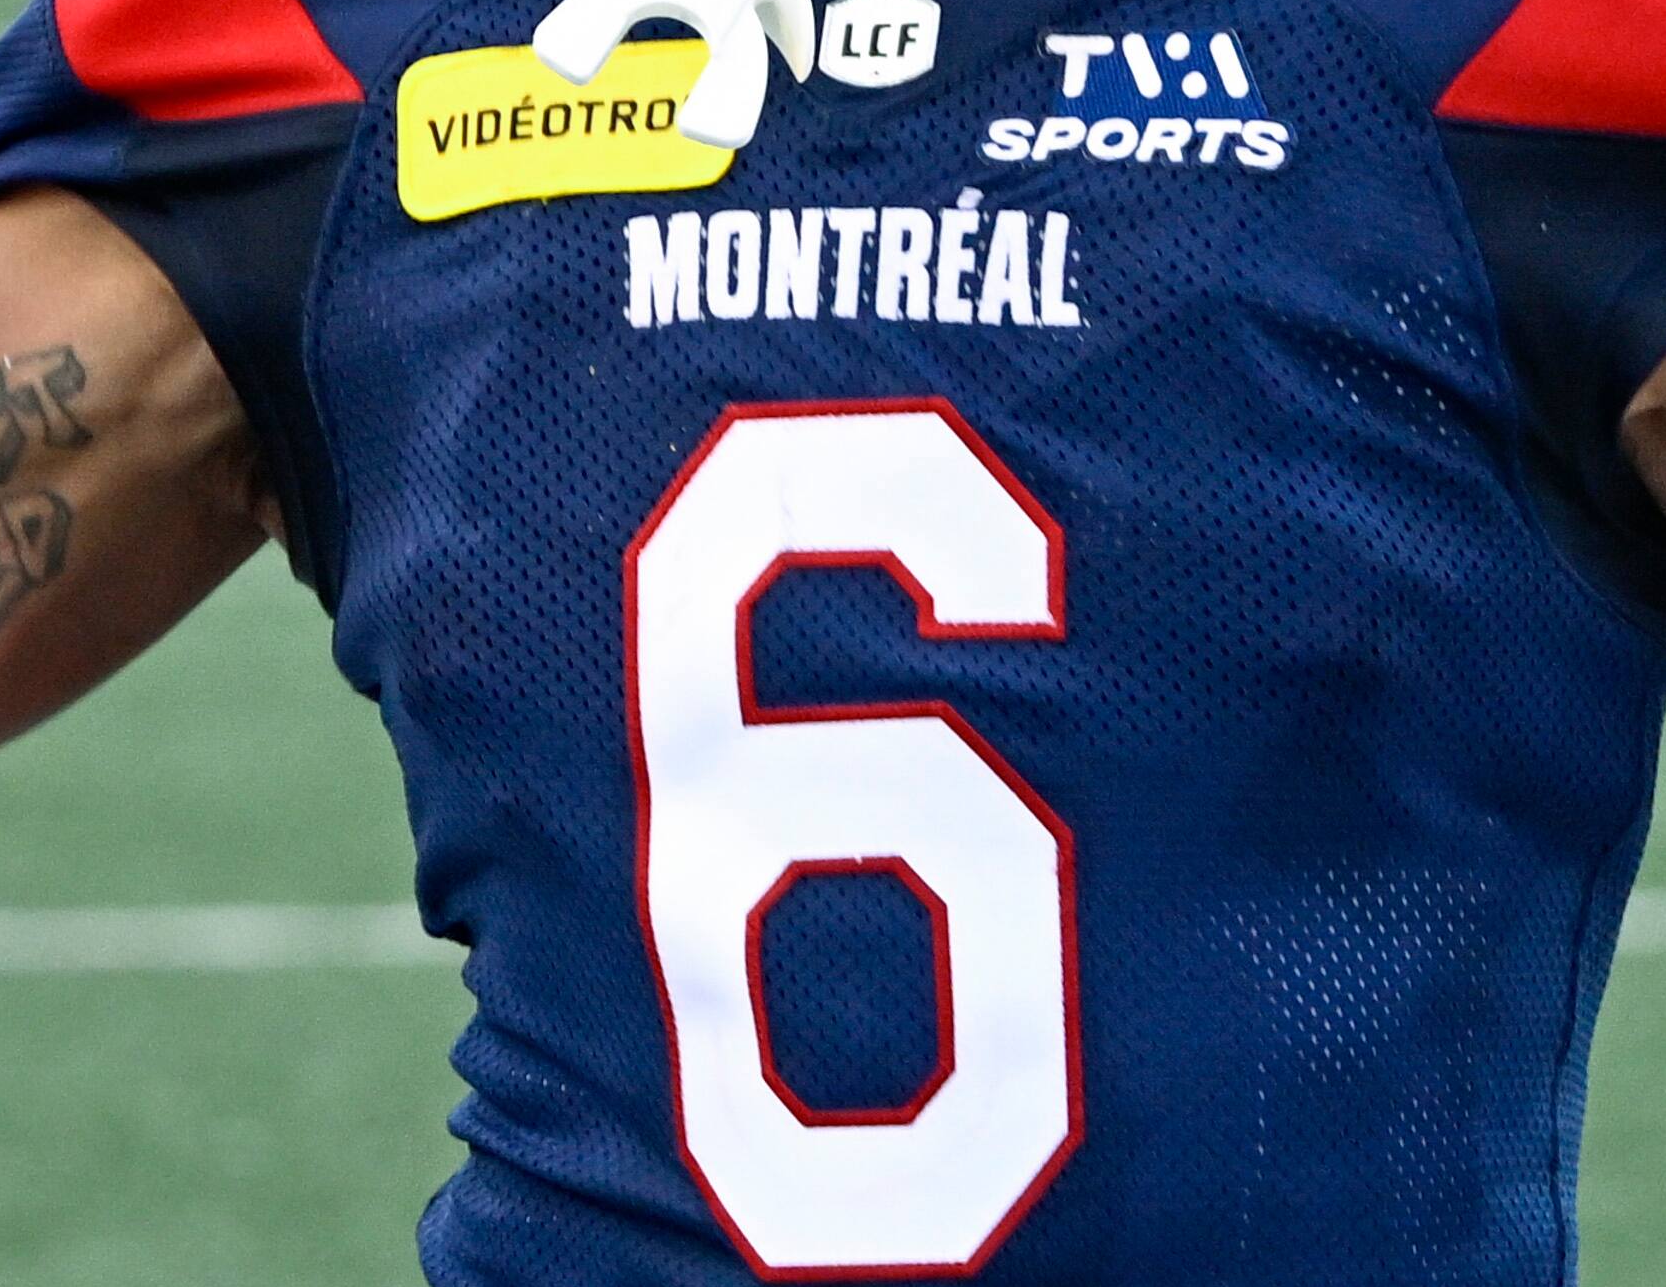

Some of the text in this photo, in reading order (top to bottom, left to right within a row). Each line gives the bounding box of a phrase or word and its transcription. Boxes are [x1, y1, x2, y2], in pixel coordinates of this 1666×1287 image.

[840, 21, 920, 58] LCF
[427, 94, 691, 156] VIDÉOTRO
[981, 116, 1290, 170] SPORTS
[627, 185, 1081, 328] MONTRÉAL
[623, 394, 1085, 1283] 6
